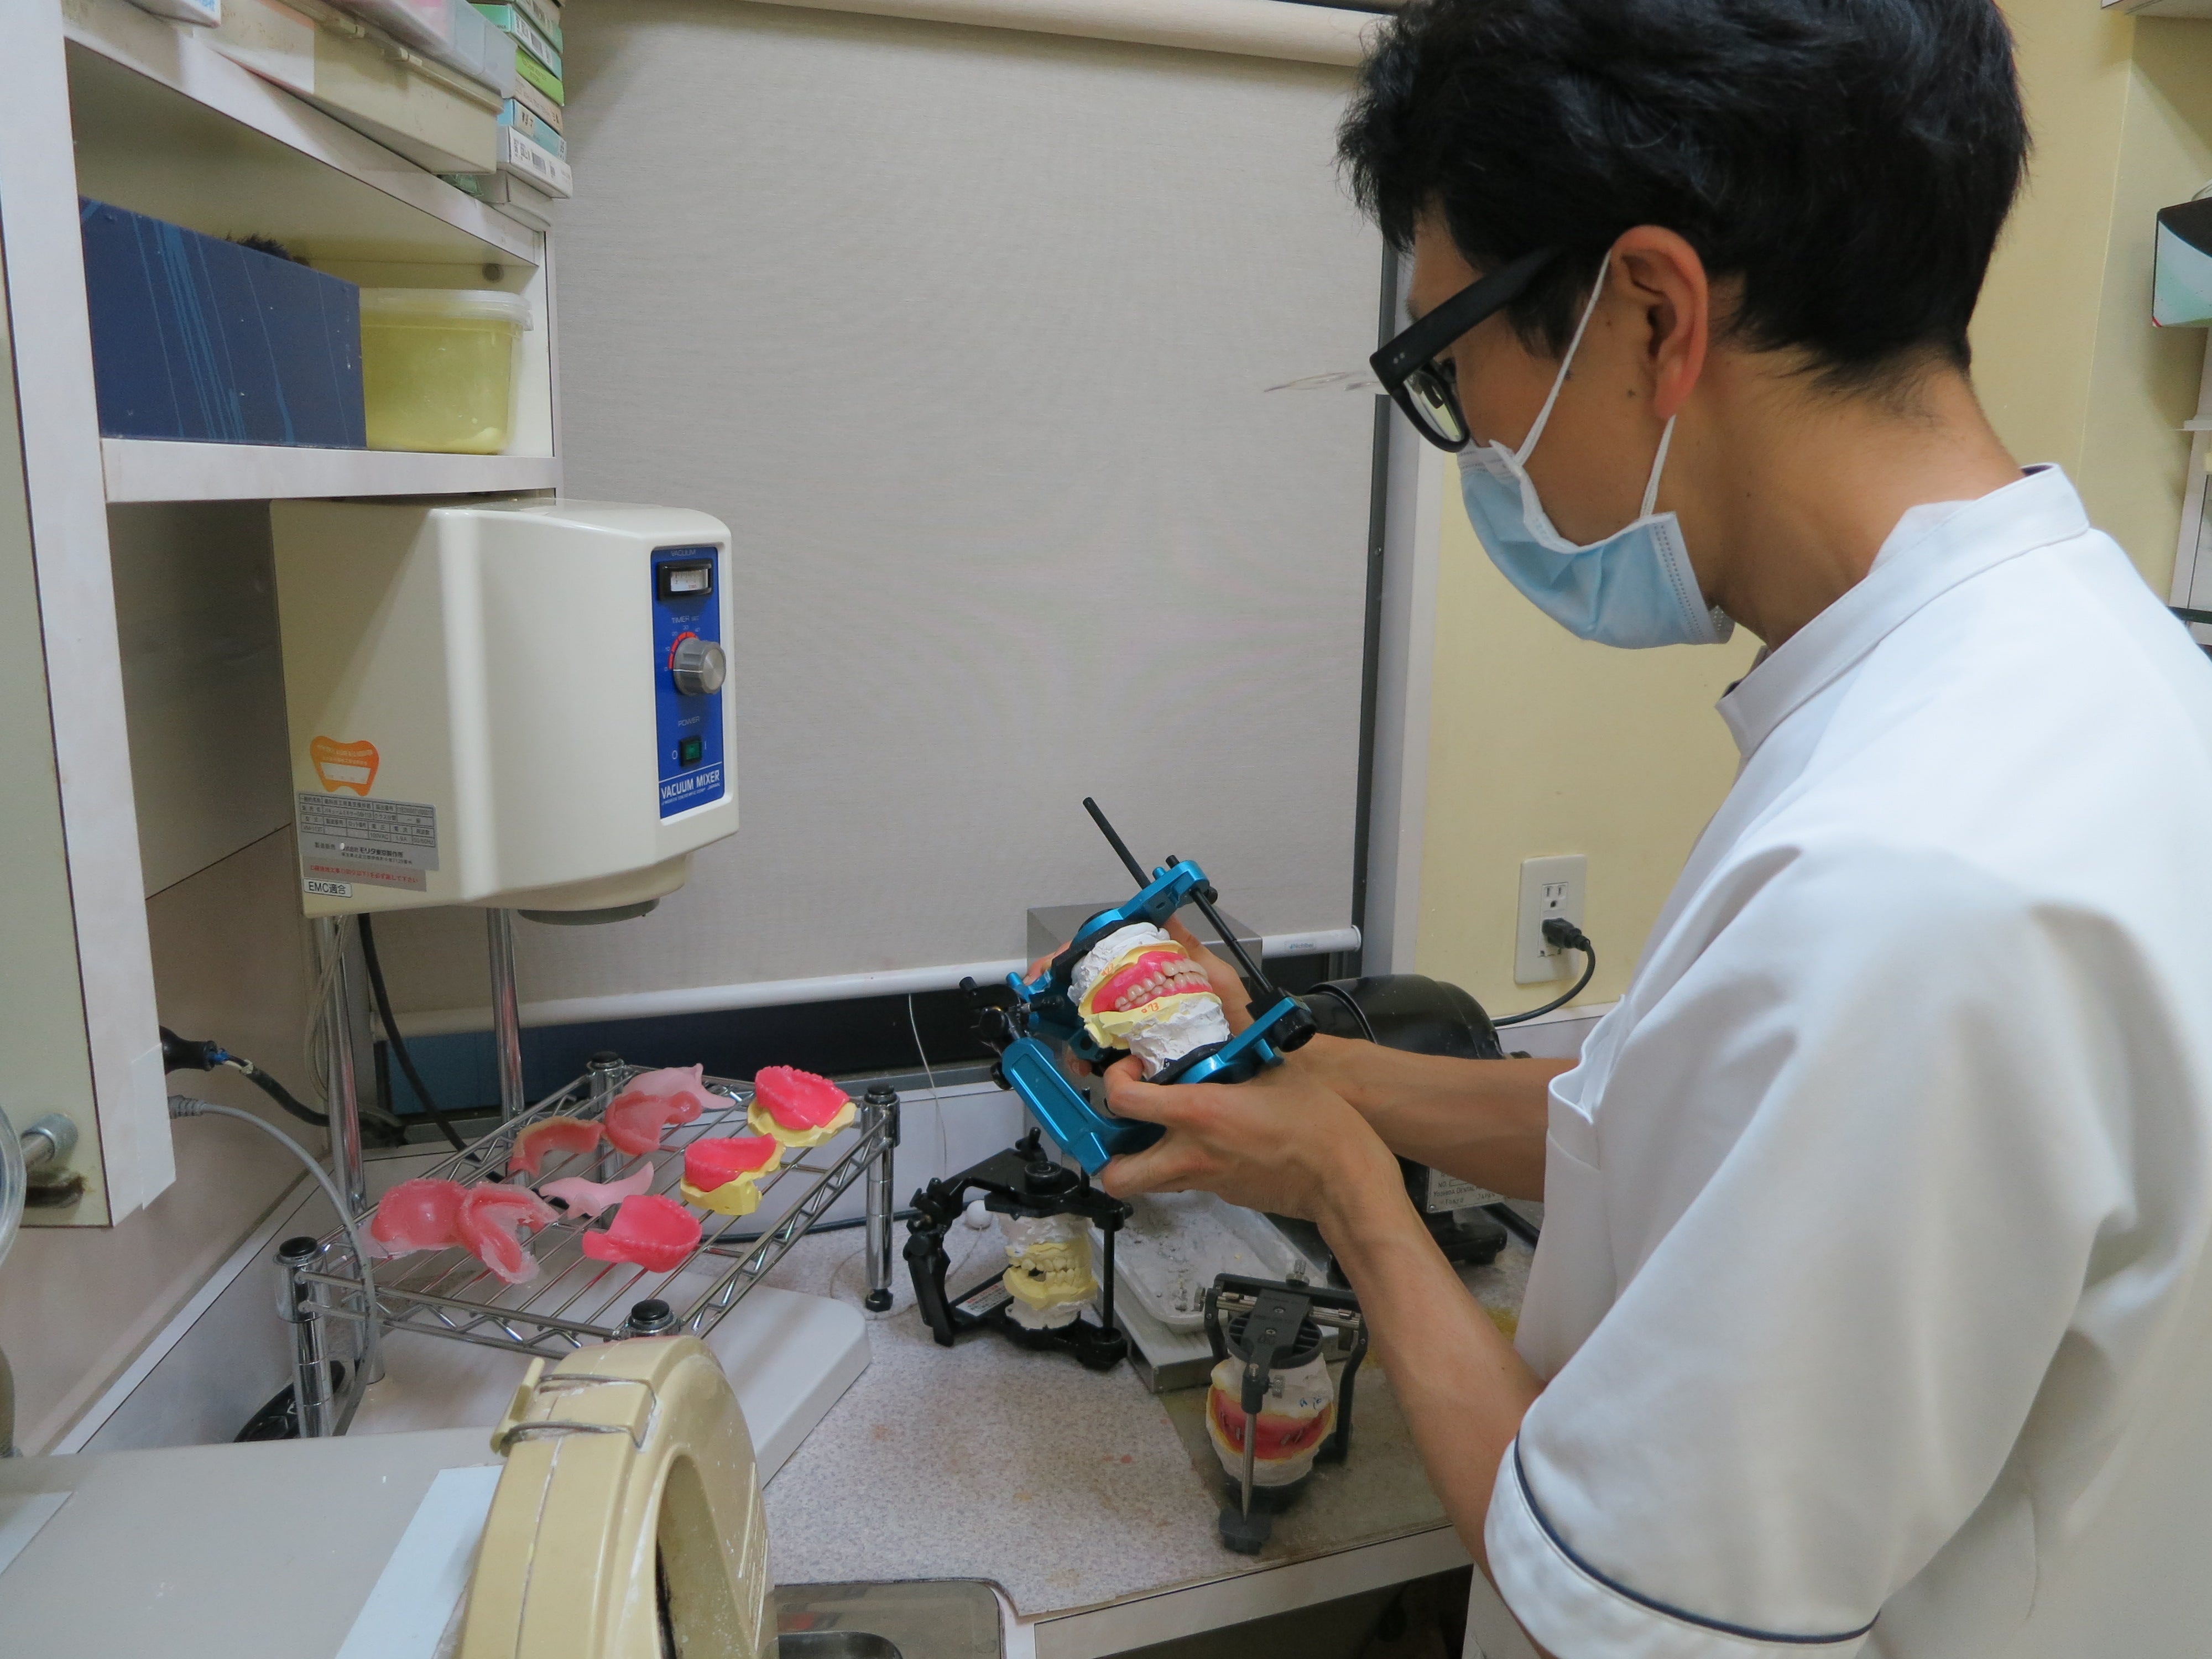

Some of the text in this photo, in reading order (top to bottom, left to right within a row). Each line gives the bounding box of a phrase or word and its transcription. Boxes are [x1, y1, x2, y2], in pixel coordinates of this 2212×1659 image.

[671, 615, 690, 624] TIMER
[678, 716, 700, 727] POWER
[661, 778, 694, 800] VACUUM
[696, 769, 720, 788] MIXER
[309, 881, 346, 894] EMC適合
